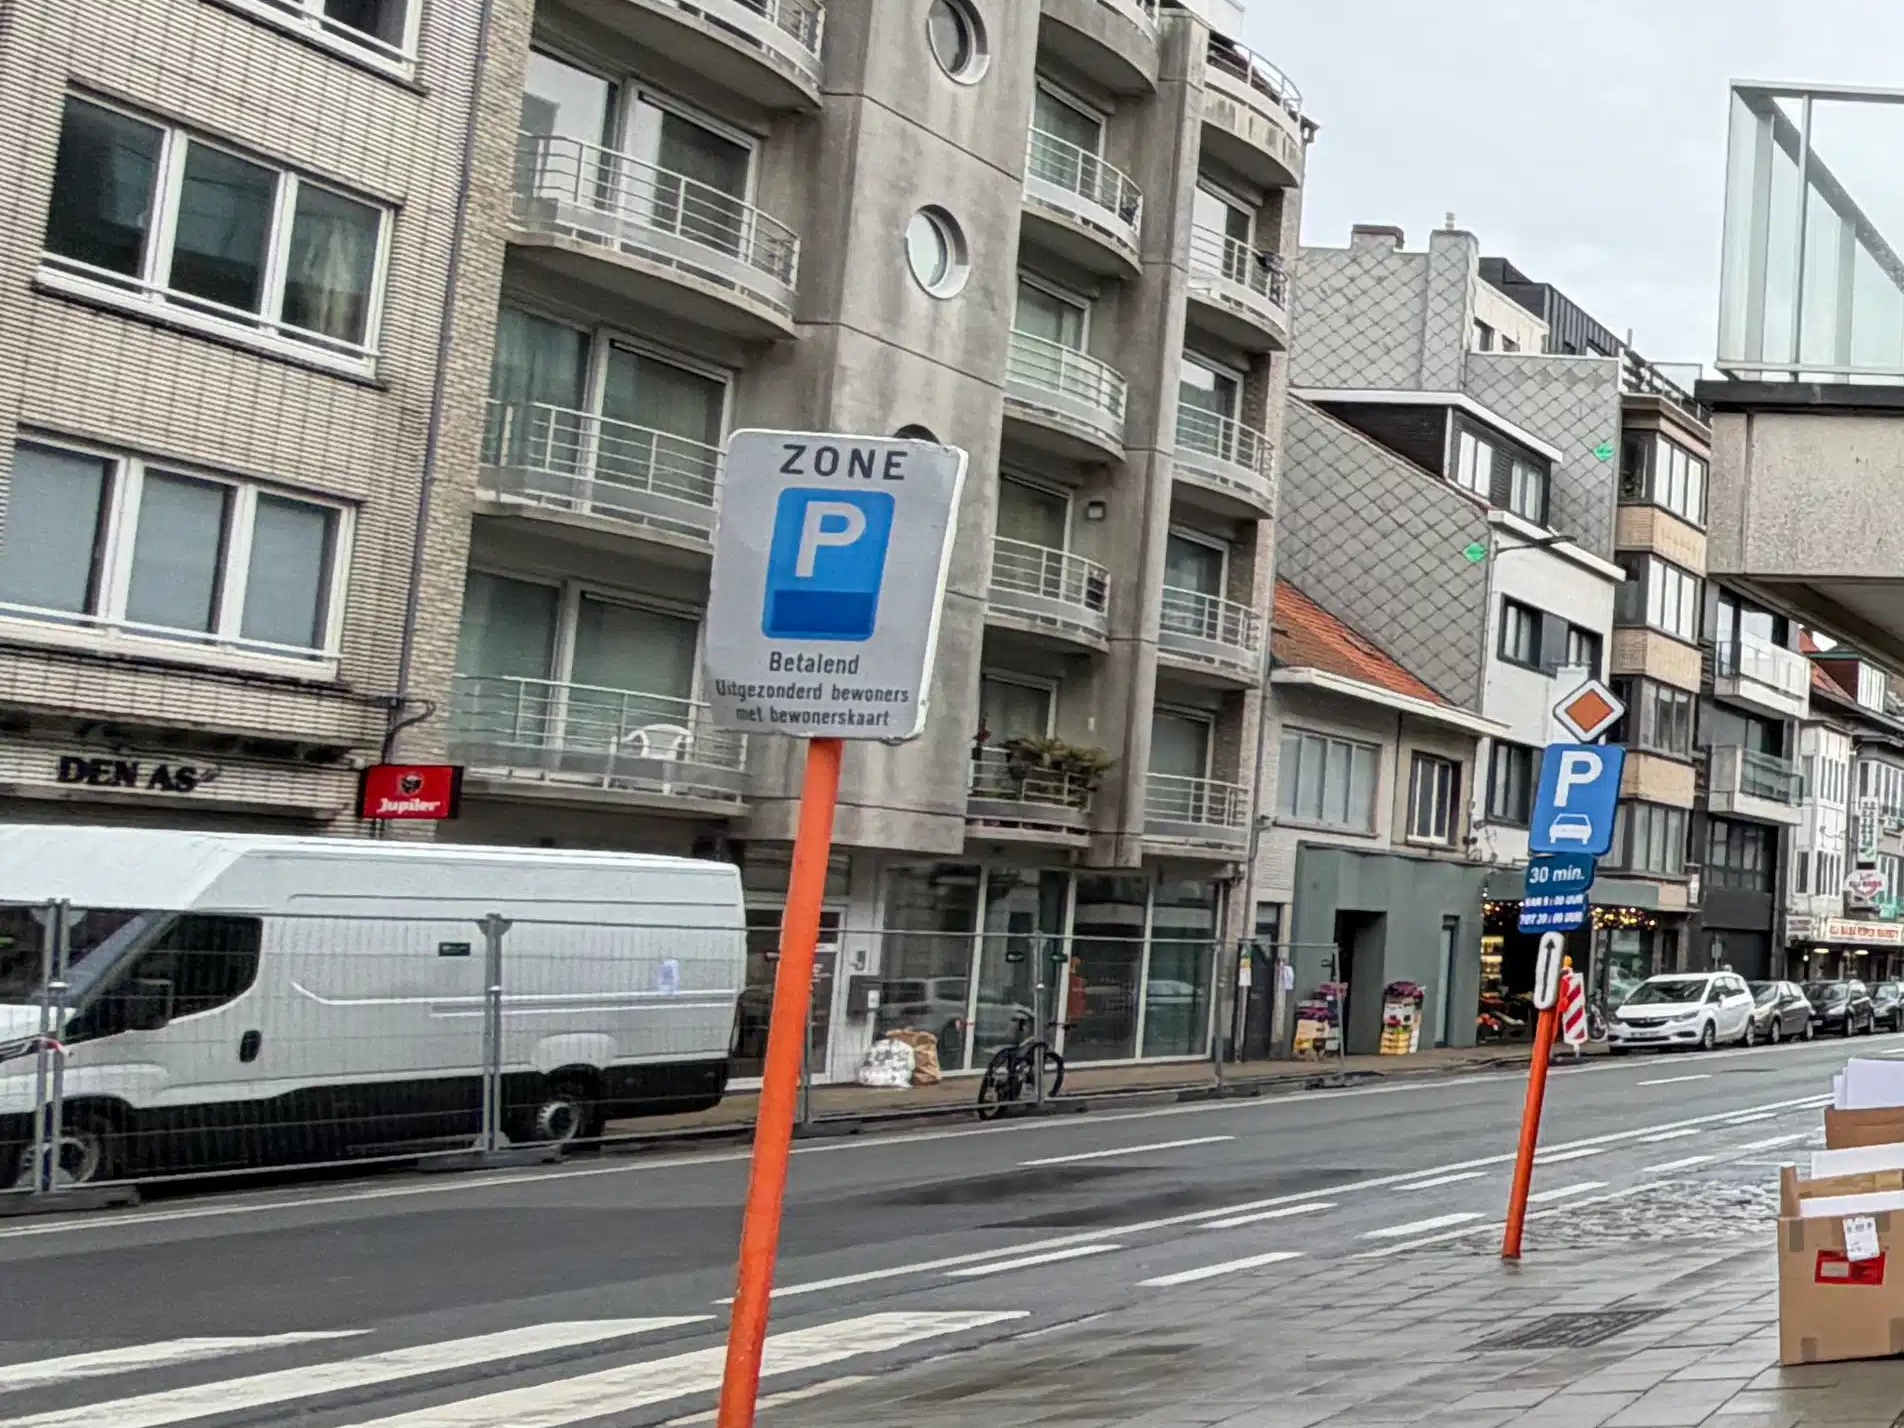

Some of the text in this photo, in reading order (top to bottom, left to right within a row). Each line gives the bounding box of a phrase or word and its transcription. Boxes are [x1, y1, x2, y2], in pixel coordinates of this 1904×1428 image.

[780, 443, 908, 481] ZONE
[795, 500, 867, 578] P
[769, 651, 860, 675] Betalend
[715, 679, 909, 703] Uitgezonderd bewoners
[736, 705, 889, 726] met bewonerskaart
[58, 756, 199, 793] DEN AS
[1553, 750, 1603, 808] P
[375, 797, 441, 815] Jupiler
[1529, 864, 1585, 883] 30 min.
